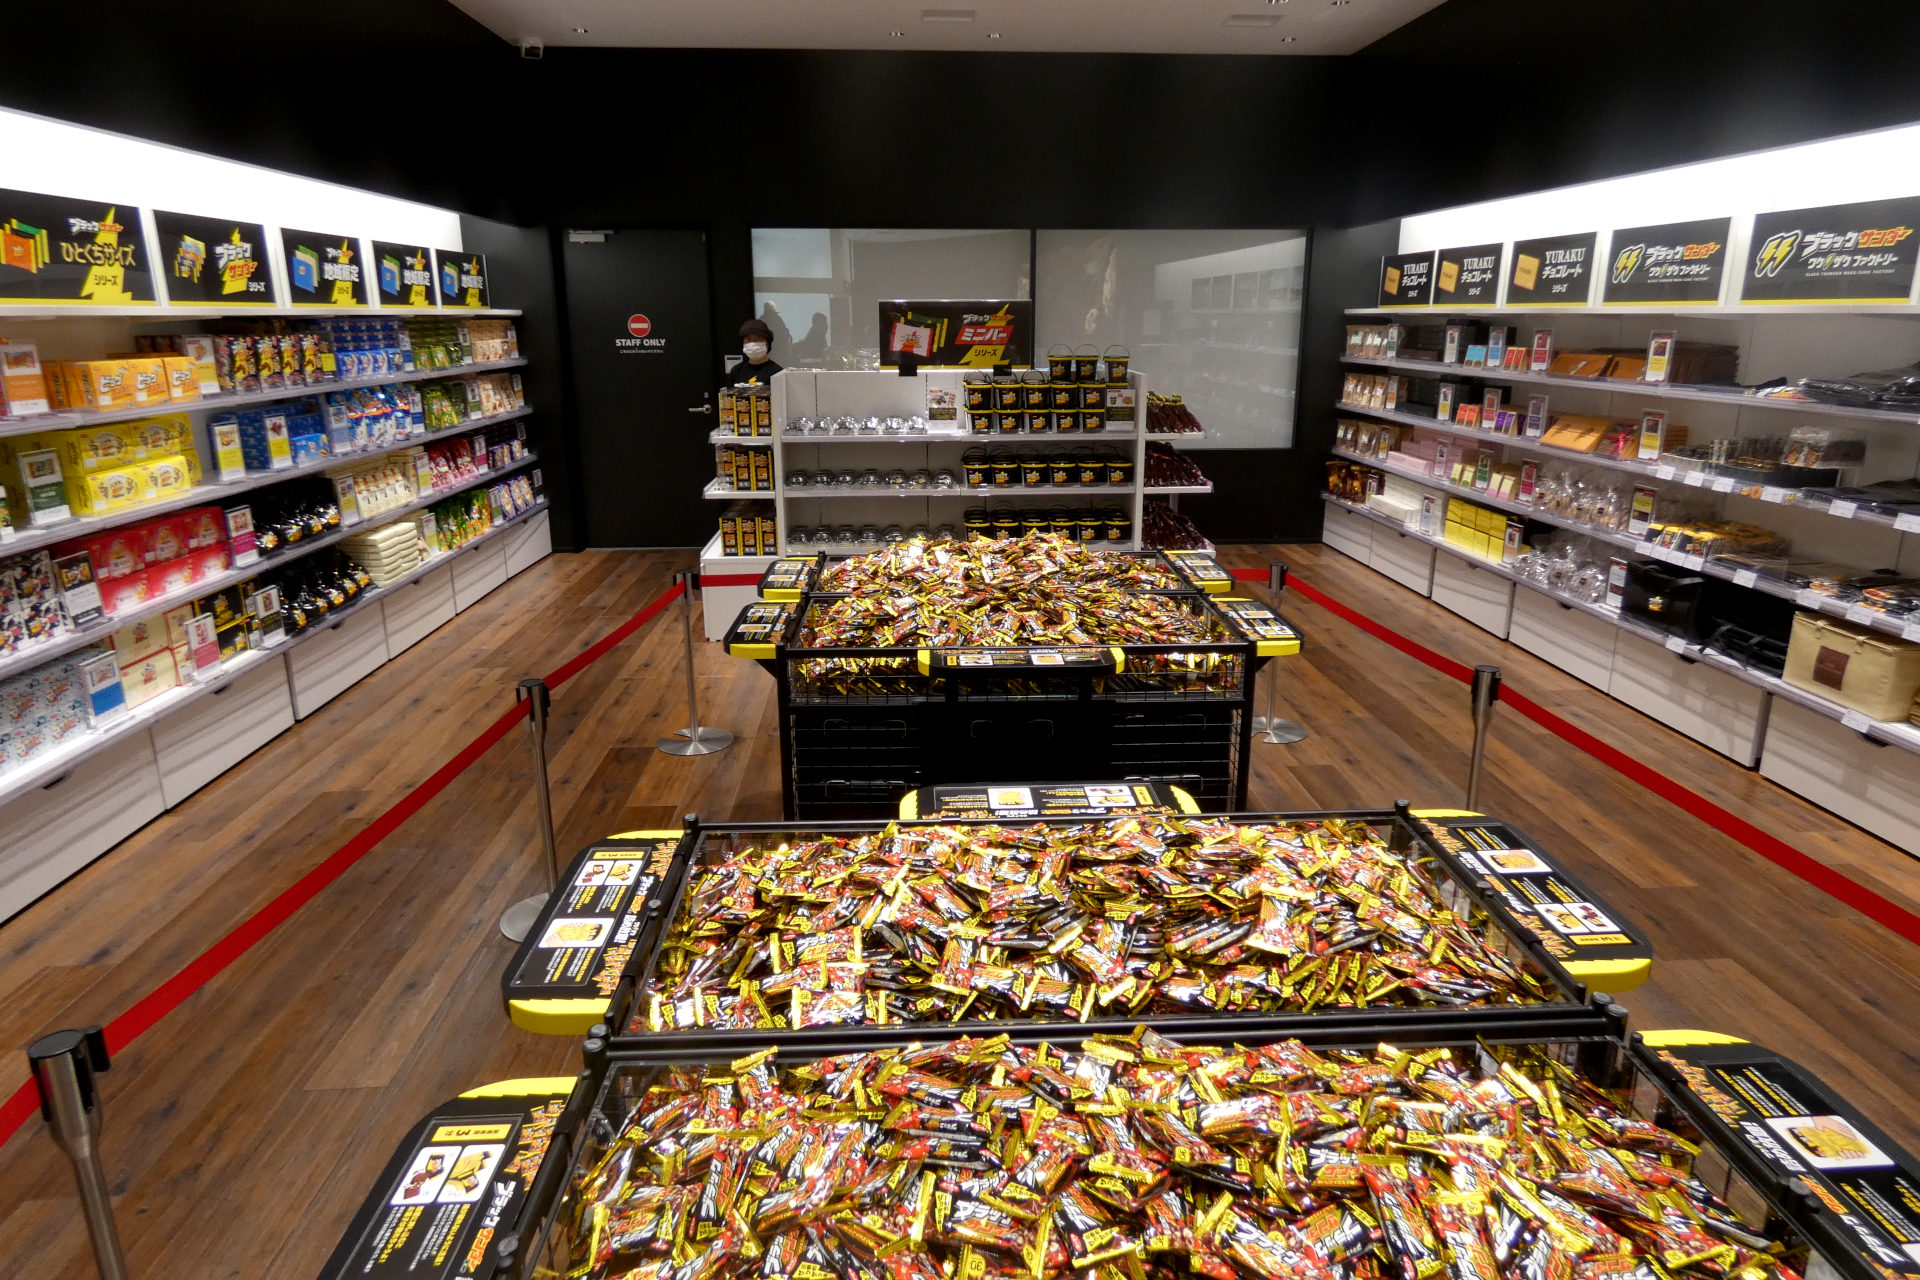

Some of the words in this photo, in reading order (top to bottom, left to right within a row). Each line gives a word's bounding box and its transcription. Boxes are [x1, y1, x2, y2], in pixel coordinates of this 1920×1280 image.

[1799, 226, 1914, 262] ブラックサンダー
[60, 242, 136, 267] ひとくちサイズ
[214, 243, 253, 274] ブラック
[1545, 248, 1587, 264] YURAKU
[1852, 254, 1899, 267] ファクトリー
[1403, 263, 1429, 274] YURAKU
[1463, 256, 1495, 270] YURAKU
[1461, 270, 1493, 283] チョコレート
[1542, 264, 1584, 279] チョコレート
[94, 275, 118, 286] シリーズ
[1402, 275, 1427, 286] チョコレート
[1468, 287, 1482, 296] シリーズ
[1552, 284, 1568, 293] シリーズ
[961, 327, 1008, 342] ミニバー
[974, 348, 998, 356] シリーズ
[795, 934, 836, 956] ブラック
[757, 1123, 795, 1165] ブラック
[700, 1158, 724, 1221] ブラック
